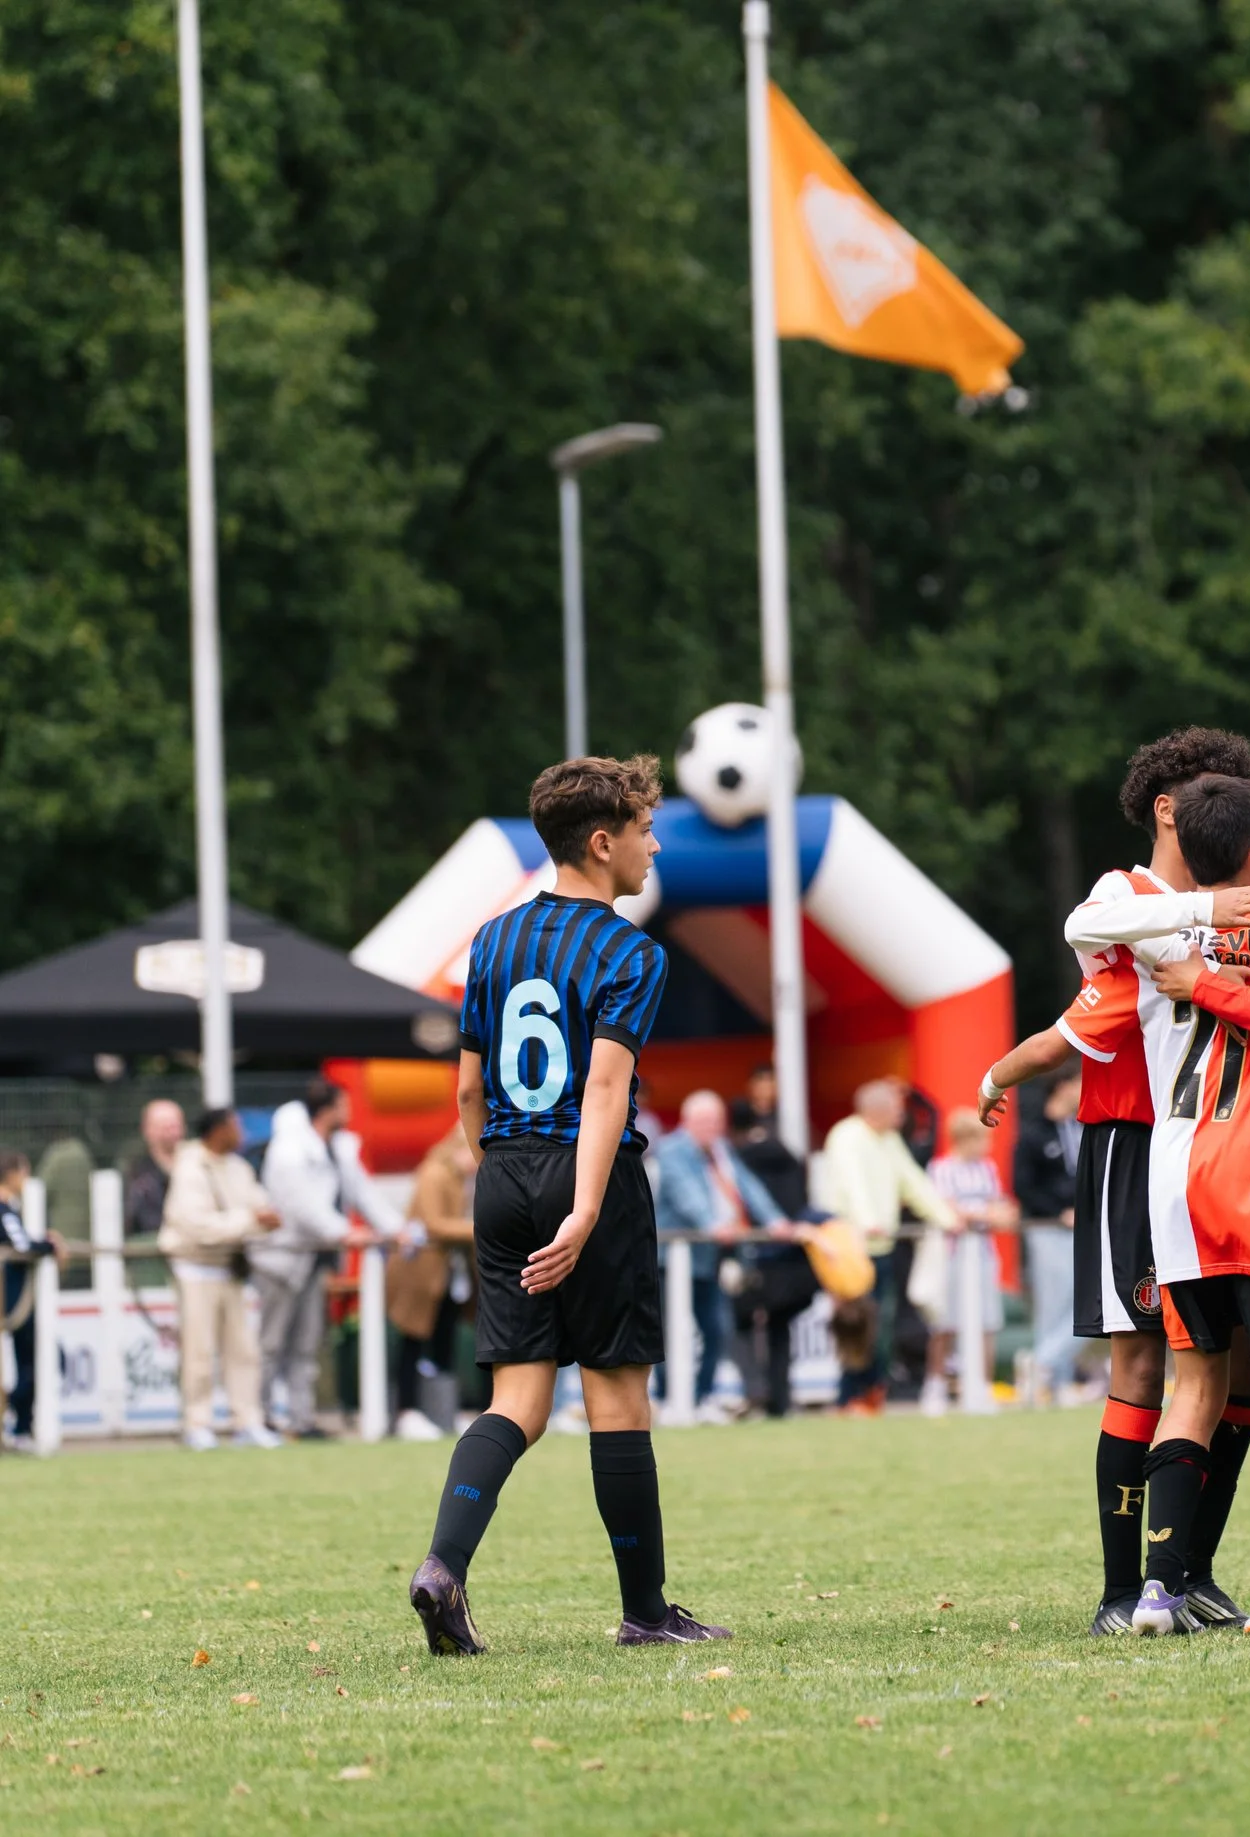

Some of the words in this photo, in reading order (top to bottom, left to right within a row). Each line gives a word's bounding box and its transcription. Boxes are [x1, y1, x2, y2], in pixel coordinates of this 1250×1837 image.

[500, 978, 568, 1112] 6
[1167, 999, 1250, 1122] 21
[453, 1483, 481, 1502] INTER
[1112, 1484, 1146, 1516] F
